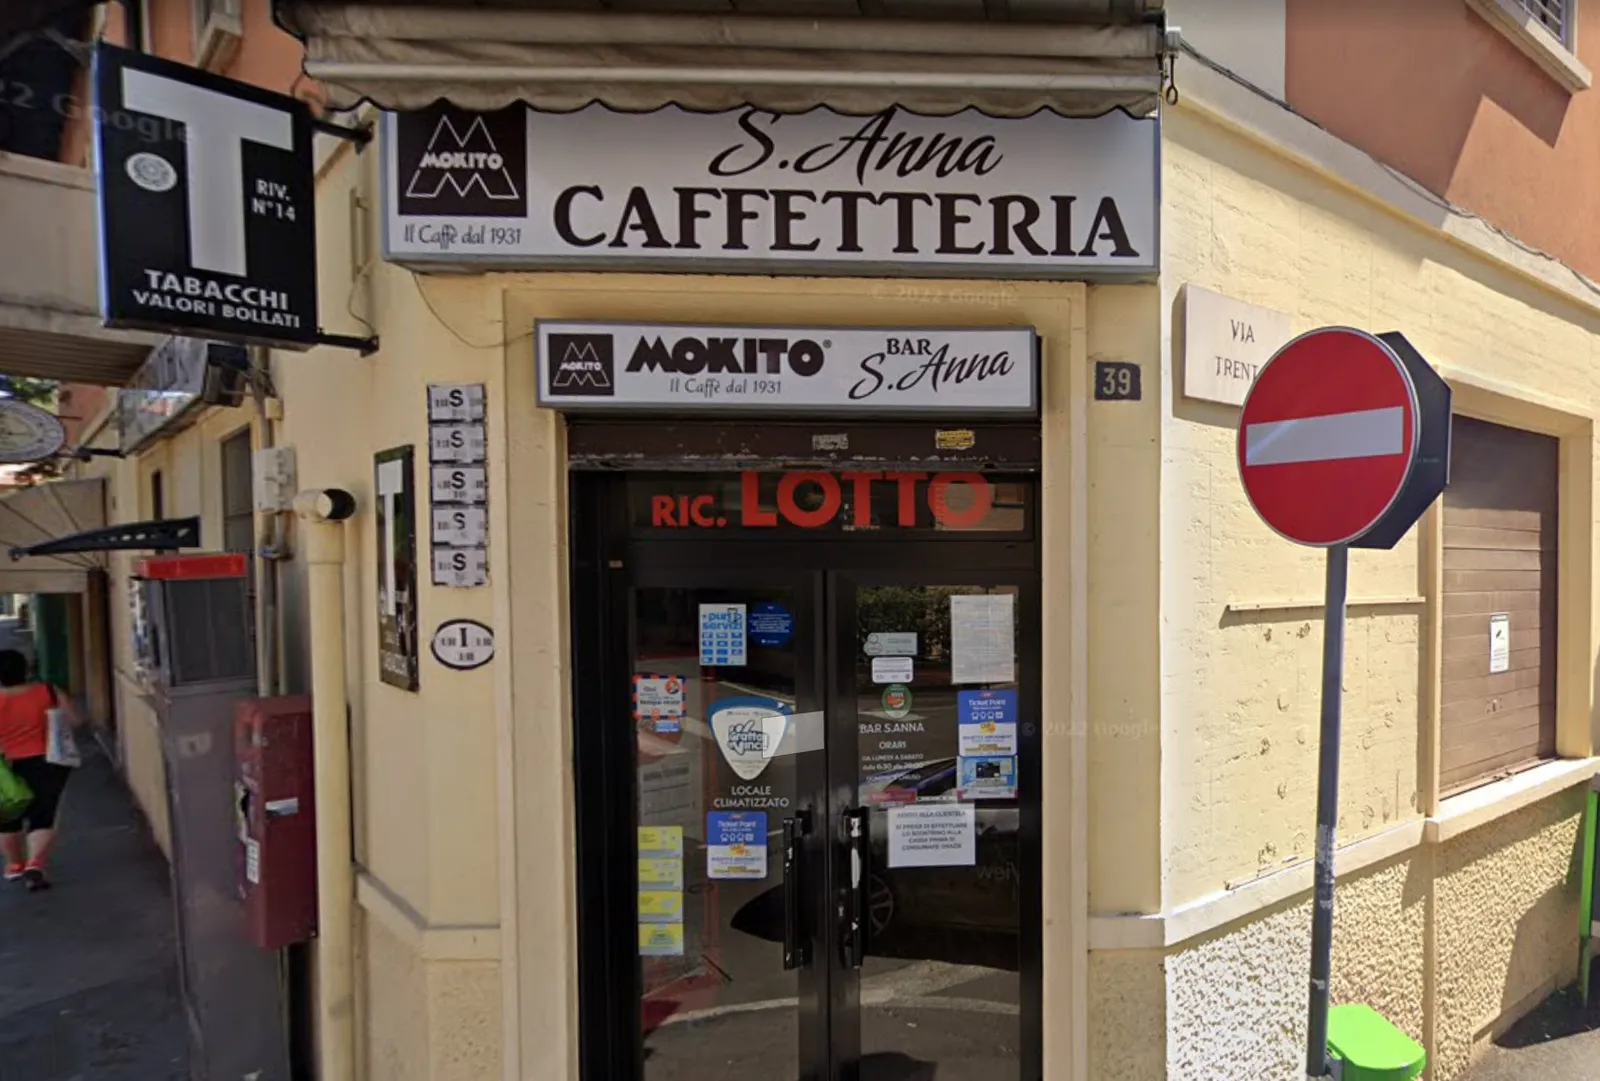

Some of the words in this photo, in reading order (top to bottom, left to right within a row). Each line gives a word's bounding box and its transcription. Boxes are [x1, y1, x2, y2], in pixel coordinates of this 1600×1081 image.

[420, 152, 503, 171] MOKITO
[120, 66, 293, 278] T
[255, 179, 291, 201] RIV.
[553, 184, 1139, 258] CAFFETTERIA
[404, 225, 413, 244] Il
[418, 224, 457, 250] Caffè
[461, 226, 485, 245] dal
[490, 228, 522, 246] 1931
[144, 268, 288, 311] TABACCHI
[132, 288, 216, 316] VALORI
[222, 304, 300, 329] BOLLATI
[1230, 318, 1255, 344] VIA
[886, 338, 933, 356] BAR
[559, 361, 602, 372] MOKITO
[1215, 355, 1259, 381] TRENT
[669, 379, 679, 393] Il
[684, 378, 720, 398] Caffè
[726, 379, 748, 394] dal
[753, 380, 782, 395] 1931
[1102, 367, 1132, 395] 39
[449, 388, 464, 408] S
[450, 429, 465, 449] S
[452, 471, 466, 490] S
[651, 494, 727, 528] RIC.
[740, 472, 990, 529] LOTTO
[453, 512, 466, 530] S
[453, 552, 467, 571] S
[859, 723, 882, 734] BAR
[731, 785, 772, 796] LOCALE
[713, 797, 790, 808] CLIMATIZZATO
